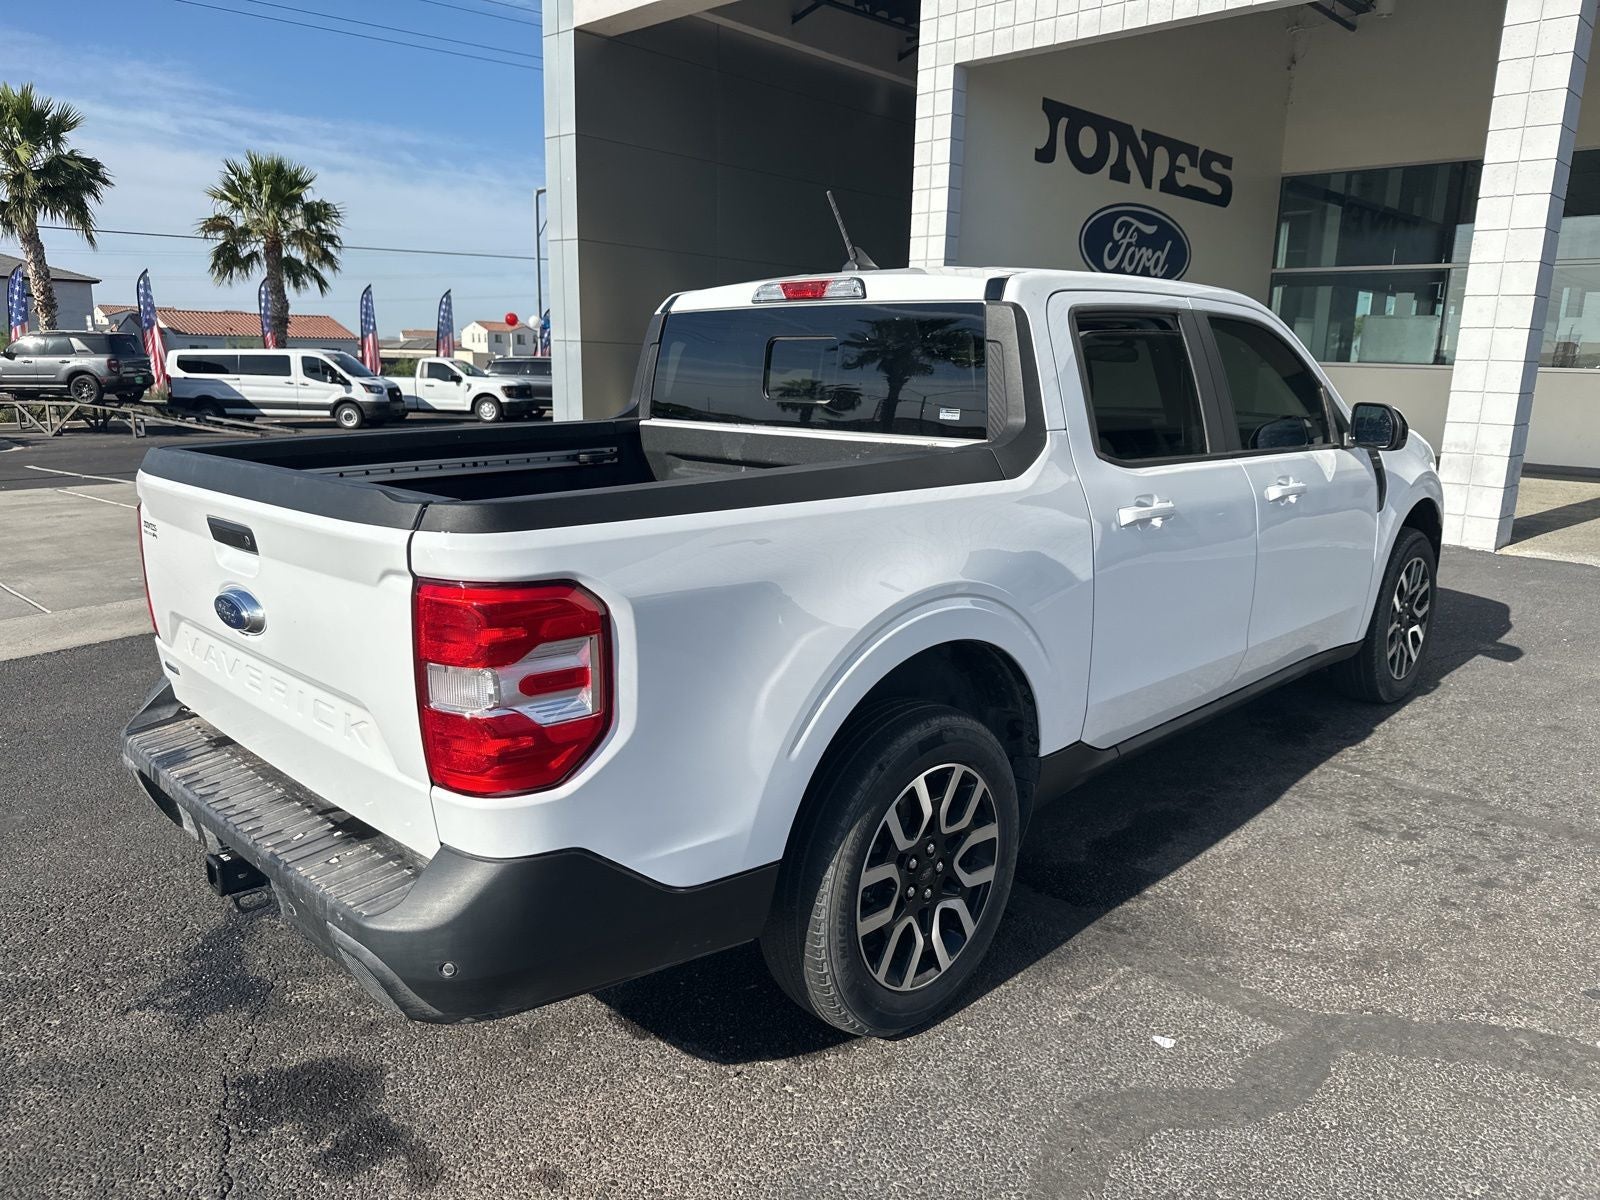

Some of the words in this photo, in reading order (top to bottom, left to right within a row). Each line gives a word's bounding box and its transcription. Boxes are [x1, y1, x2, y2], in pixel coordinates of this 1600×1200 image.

[1035, 97, 1233, 208] JONES
[1103, 215, 1172, 277] Ford
[183, 630, 370, 749] MAVERICK
